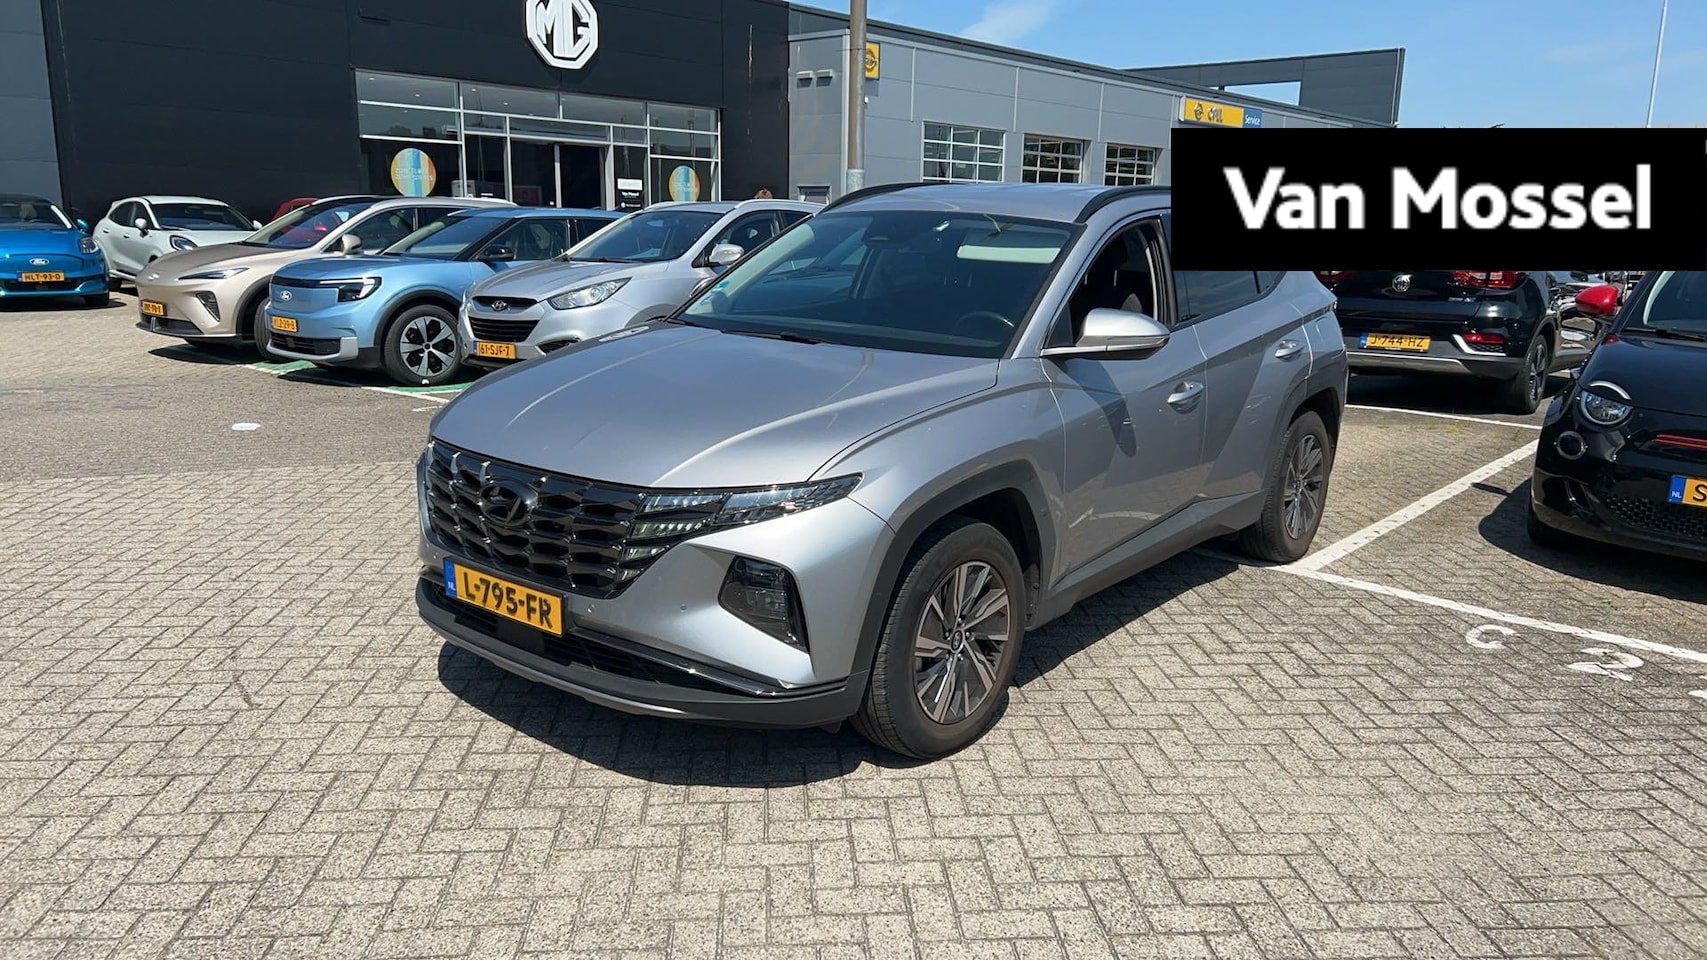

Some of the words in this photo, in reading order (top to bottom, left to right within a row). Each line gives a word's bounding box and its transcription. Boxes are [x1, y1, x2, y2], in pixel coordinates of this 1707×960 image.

[534, 0, 592, 58] MG
[1244, 114, 1261, 126] Service
[1370, 334, 1425, 348] J-744-HZ
[1671, 491, 1682, 499] NL
[463, 571, 553, 630] L-795-FR
